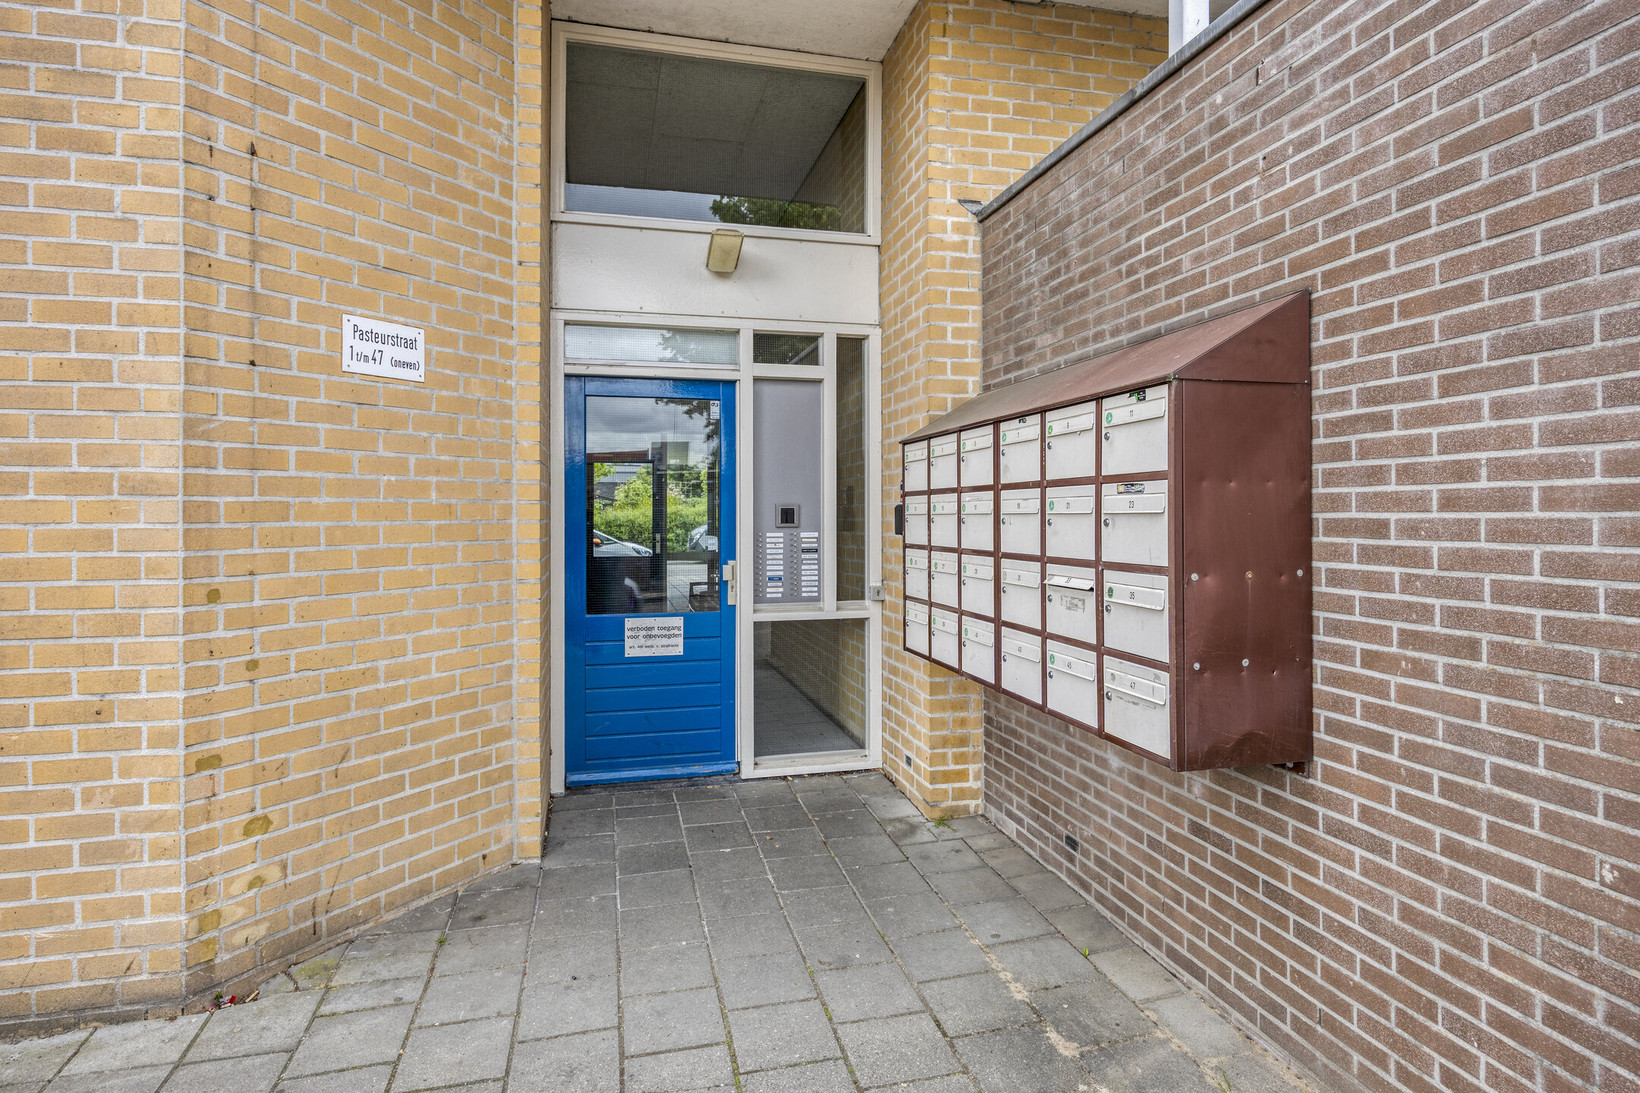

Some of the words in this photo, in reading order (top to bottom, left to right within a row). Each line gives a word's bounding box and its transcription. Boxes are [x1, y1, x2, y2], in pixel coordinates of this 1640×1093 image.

[353, 324, 418, 351] Pasteurstraat
[350, 345, 354, 361] 1
[356, 352, 370, 364] t/m
[371, 349, 384, 365] 47
[390, 357, 420, 371] (oneven)
[1128, 500, 1135, 509] 23
[1129, 591, 1135, 600] 35
